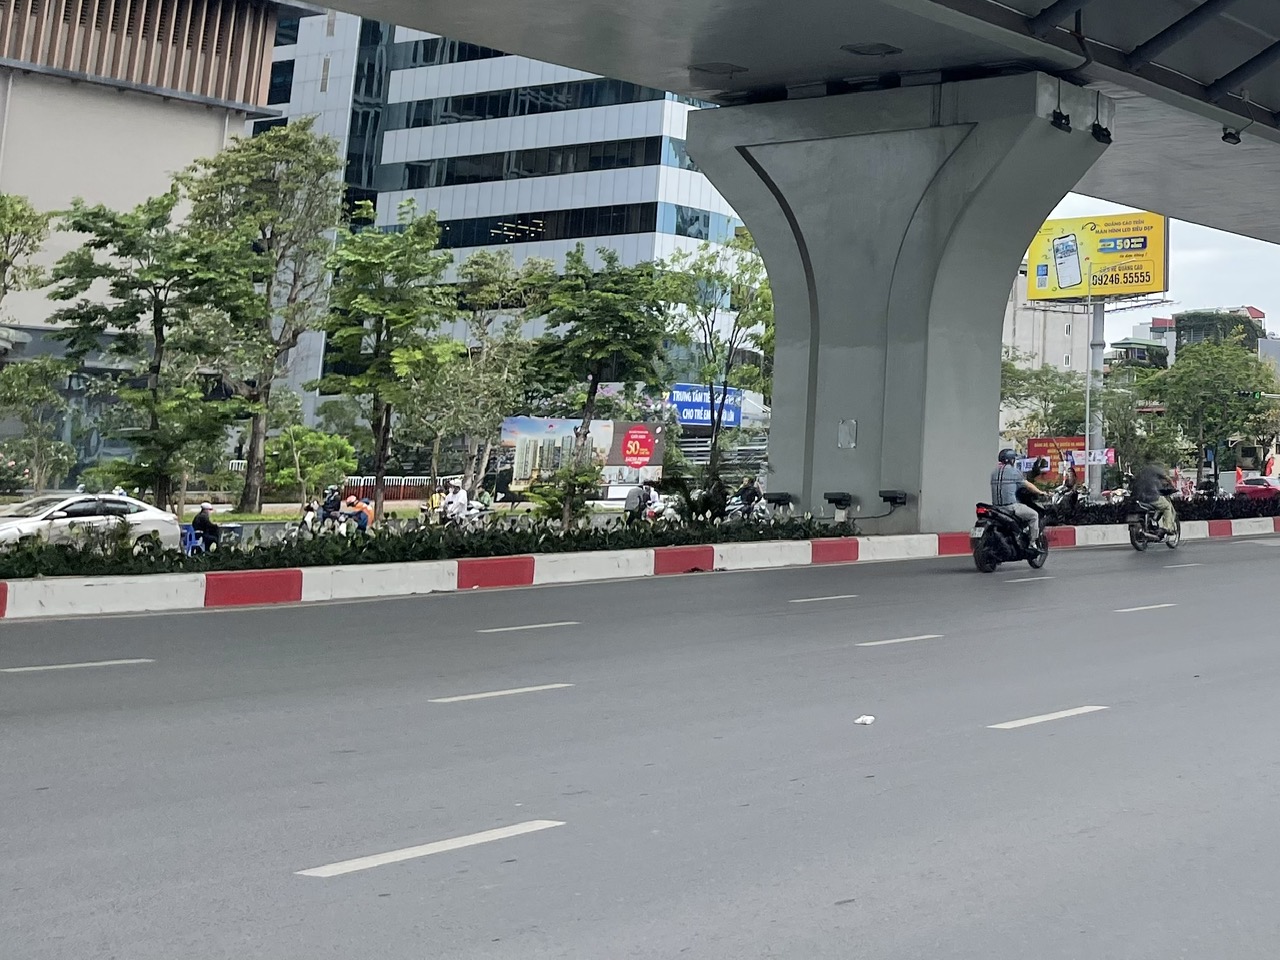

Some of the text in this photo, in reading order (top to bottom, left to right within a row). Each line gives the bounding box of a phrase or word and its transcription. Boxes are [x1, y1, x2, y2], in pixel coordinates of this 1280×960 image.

[1116, 239, 1130, 250] 50
[1092, 271, 1151, 286] 09246.55555
[672, 390, 692, 403] TRUNG
[682, 408, 694, 420] CHO
[626, 440, 640, 455] 50
